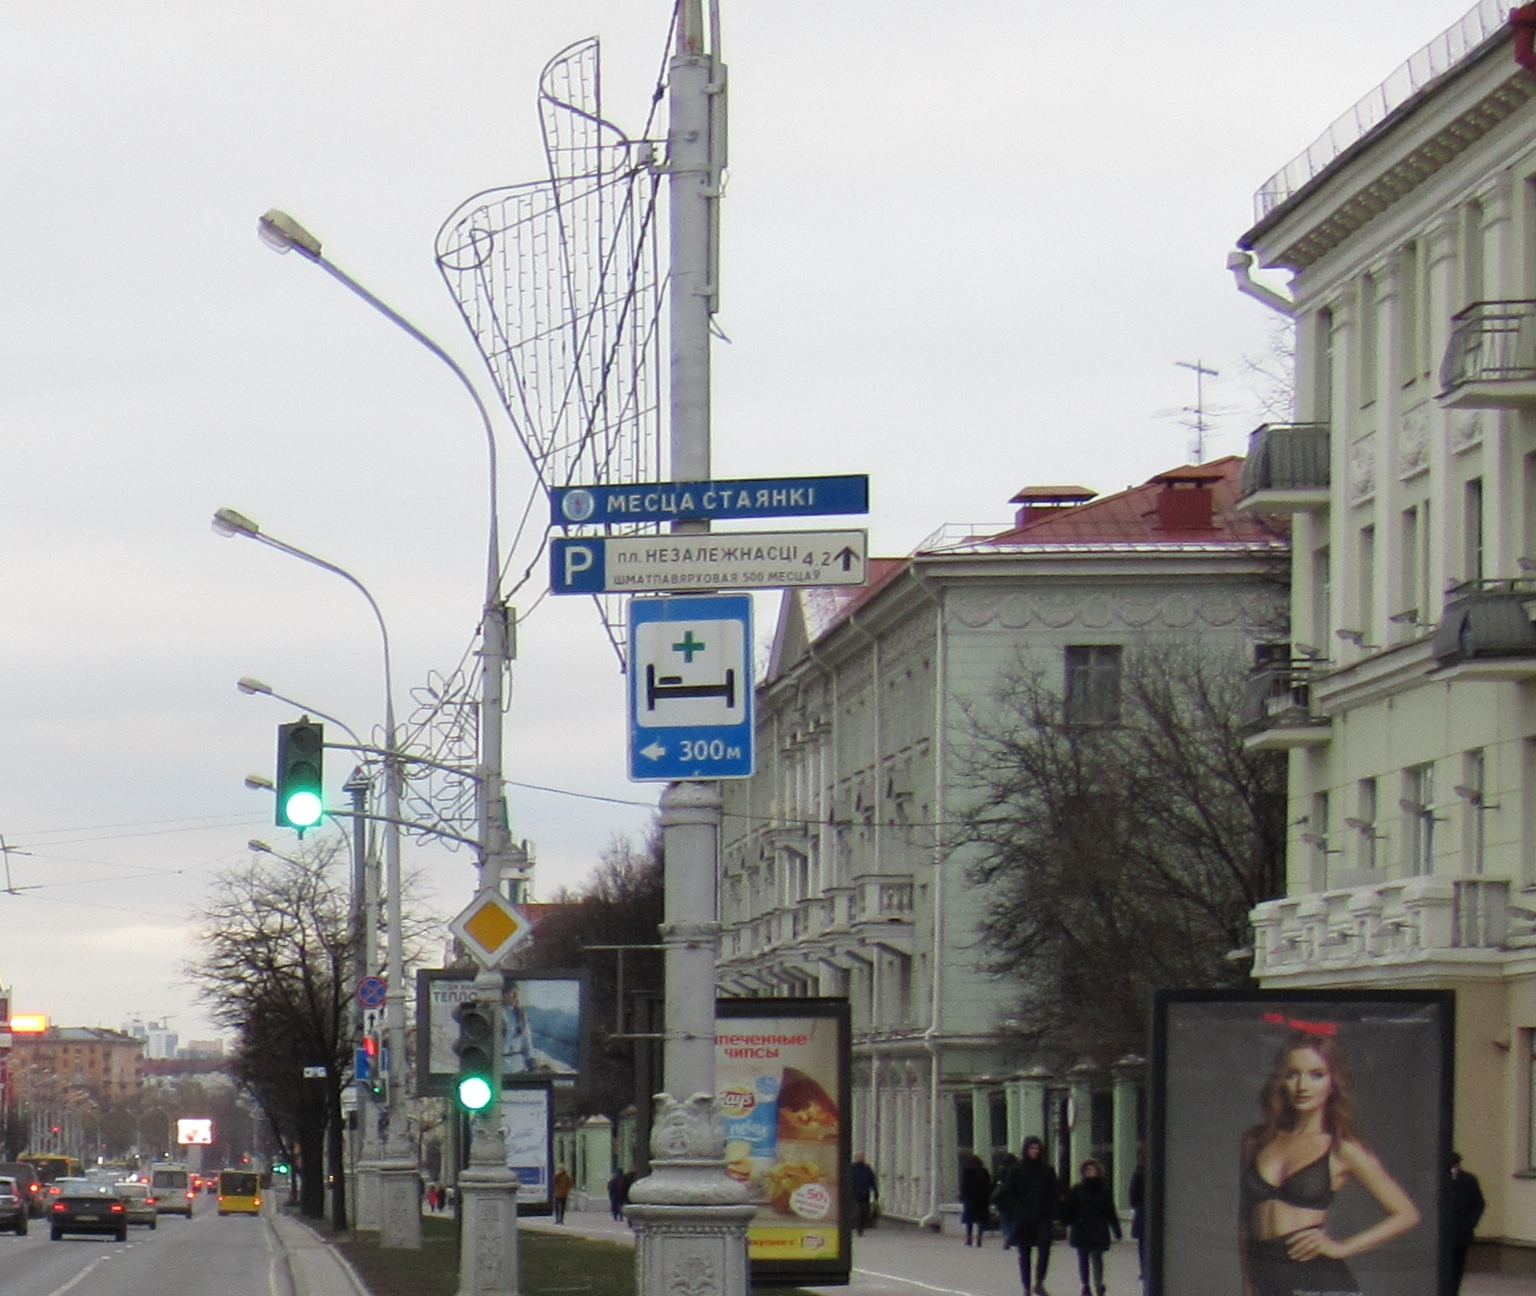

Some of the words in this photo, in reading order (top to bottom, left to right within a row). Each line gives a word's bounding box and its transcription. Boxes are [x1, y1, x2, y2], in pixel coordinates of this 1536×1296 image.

[607, 493, 695, 514] МЕСЦА
[702, 488, 815, 510] СТАЯНКІ
[617, 552, 641, 563] пл.
[646, 546, 798, 563] НЕЗАЛЕЖНАСЦІ
[614, 572, 739, 586] ШМАТПАВЯРХОВАЯ
[742, 571, 764, 582] 500
[768, 570, 821, 582] МЕСЦАЎ
[725, 1048, 779, 1058] чипсы
